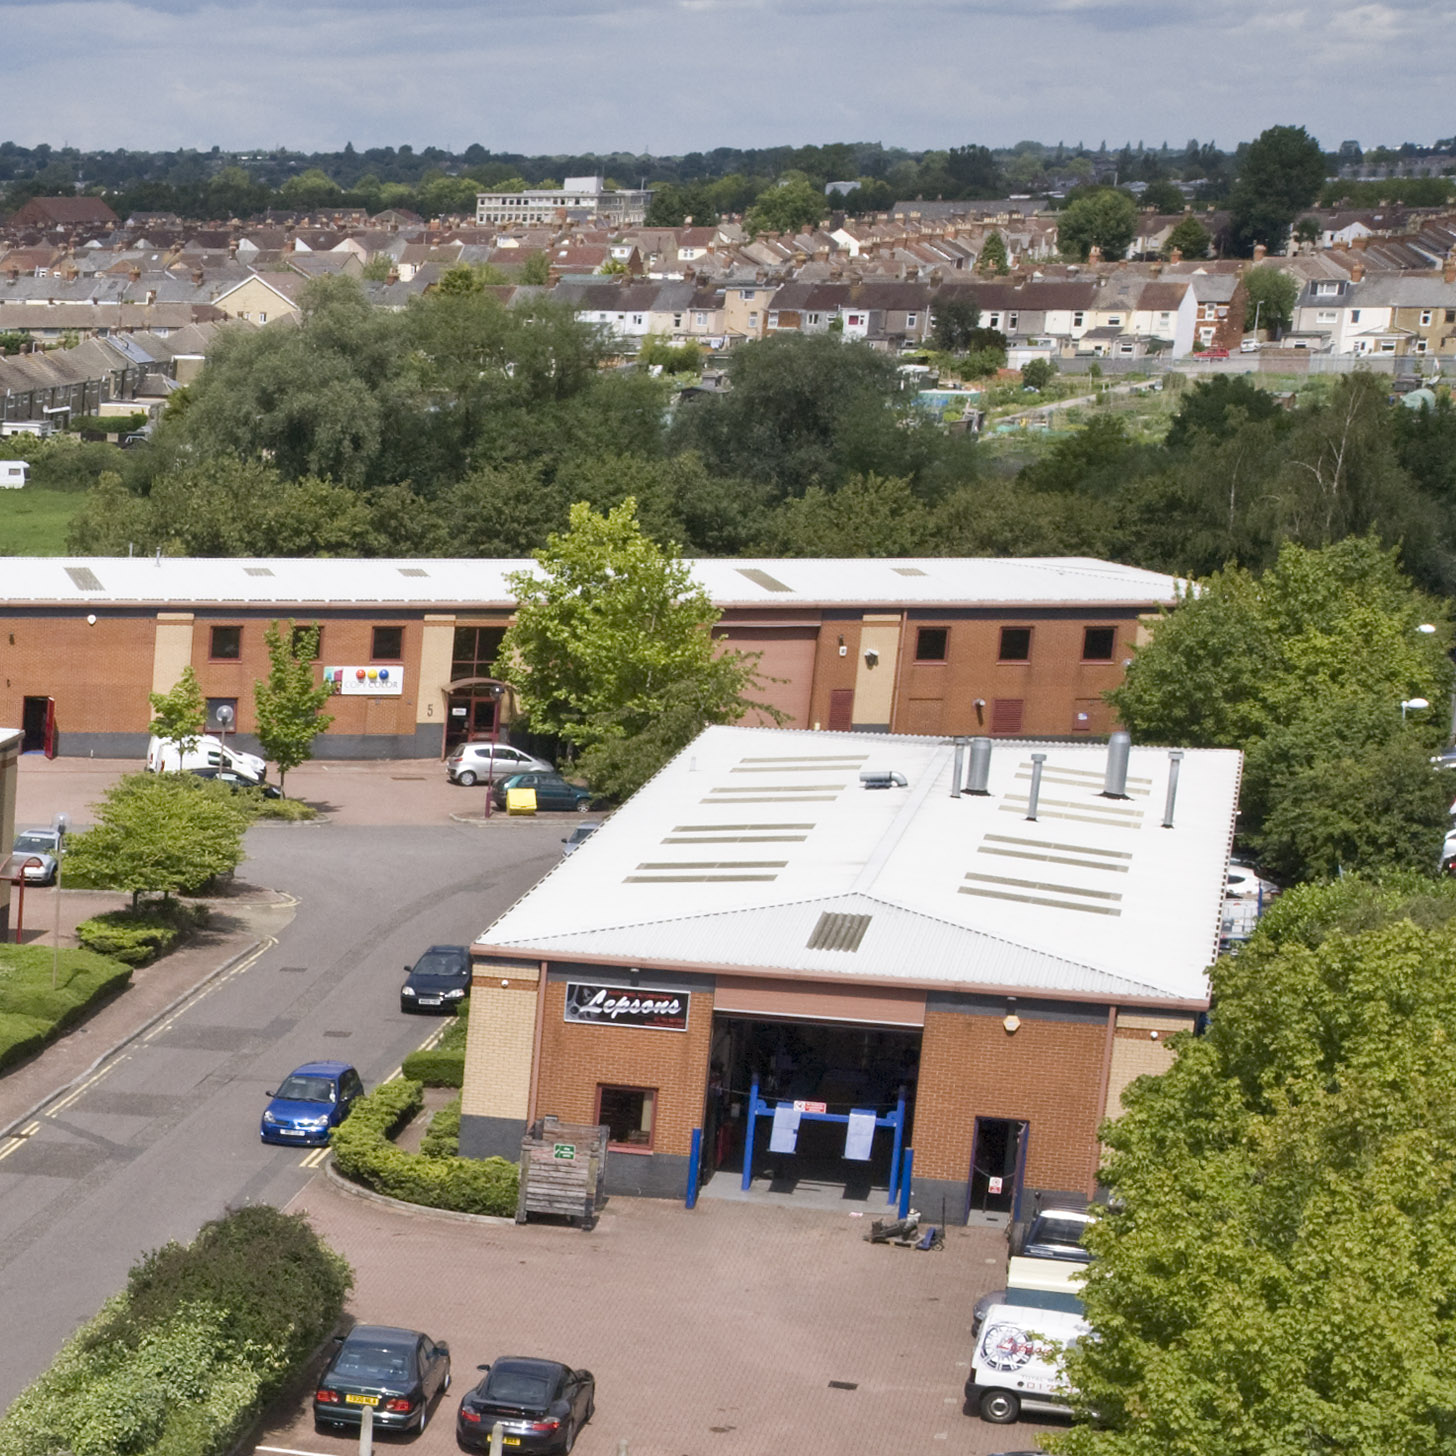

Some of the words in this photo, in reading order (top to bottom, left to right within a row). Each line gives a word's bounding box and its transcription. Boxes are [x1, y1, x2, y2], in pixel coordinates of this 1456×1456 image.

[369, 680, 399, 690] COLOR
[426, 703, 434, 718] 5
[579, 989, 682, 1019] Lepsons
